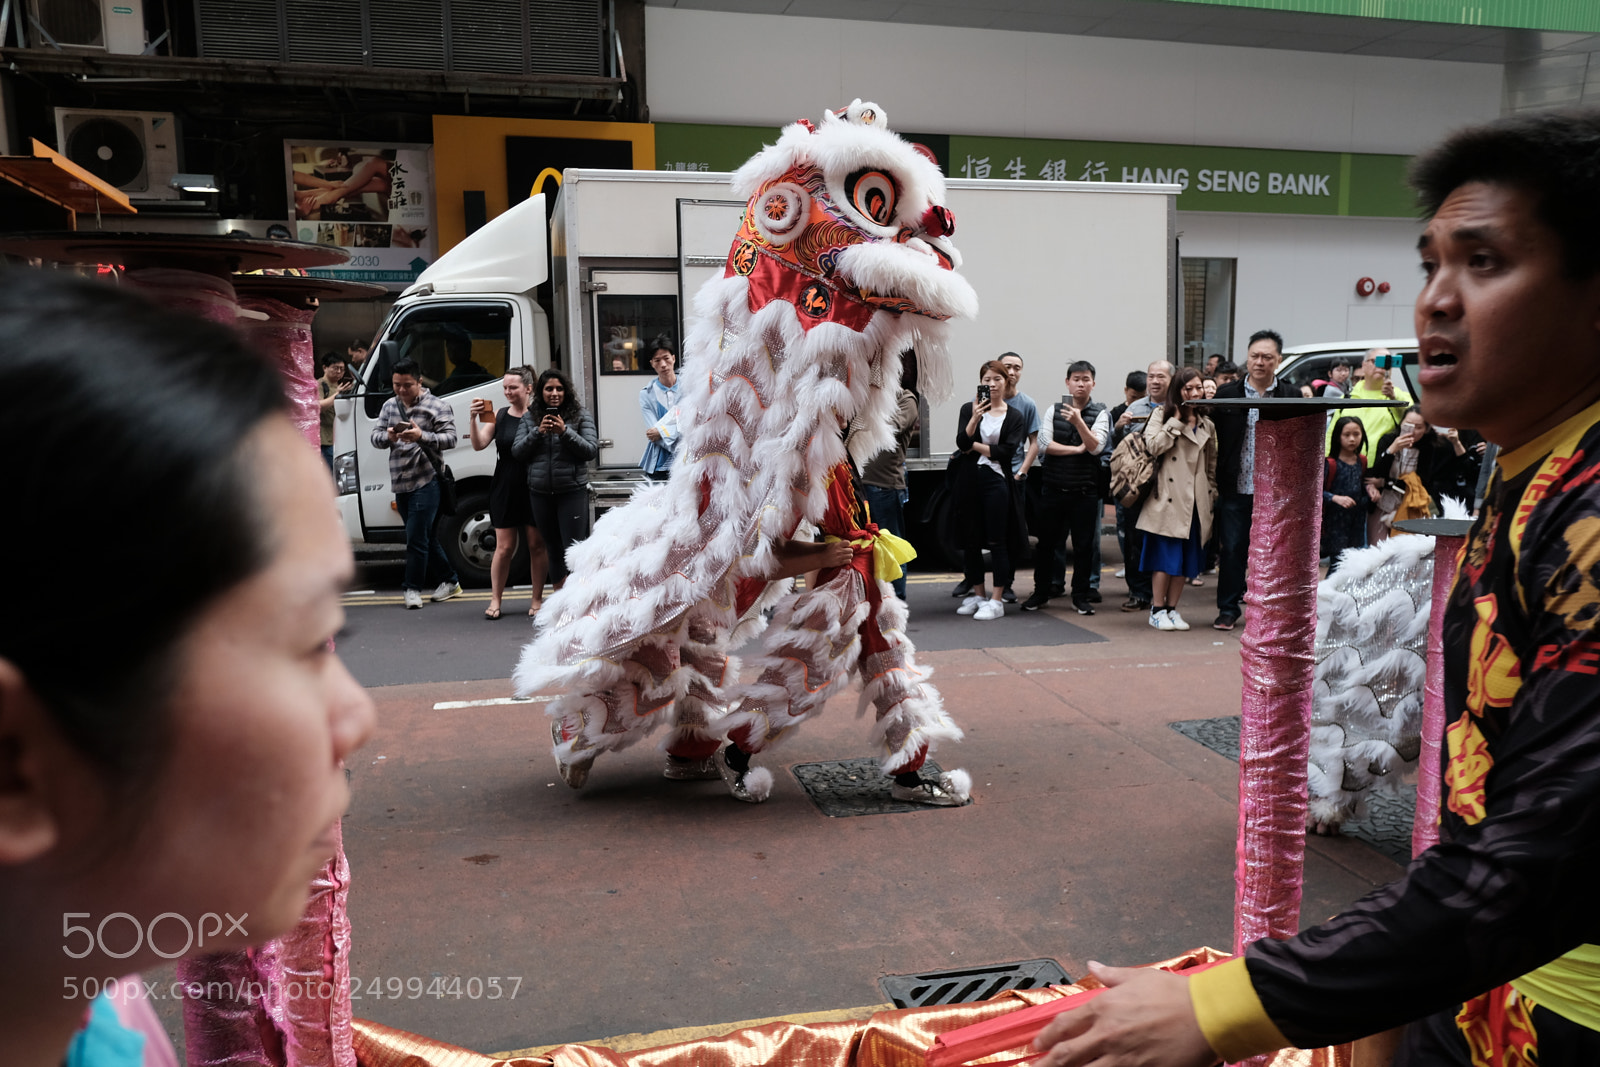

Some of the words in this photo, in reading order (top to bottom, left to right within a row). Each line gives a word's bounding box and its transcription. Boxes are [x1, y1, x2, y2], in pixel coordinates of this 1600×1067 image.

[1121, 166, 1189, 190] HANG
[1197, 169, 1260, 193] SENG
[1268, 173, 1330, 197] BANK
[350, 255, 380, 267] 2030
